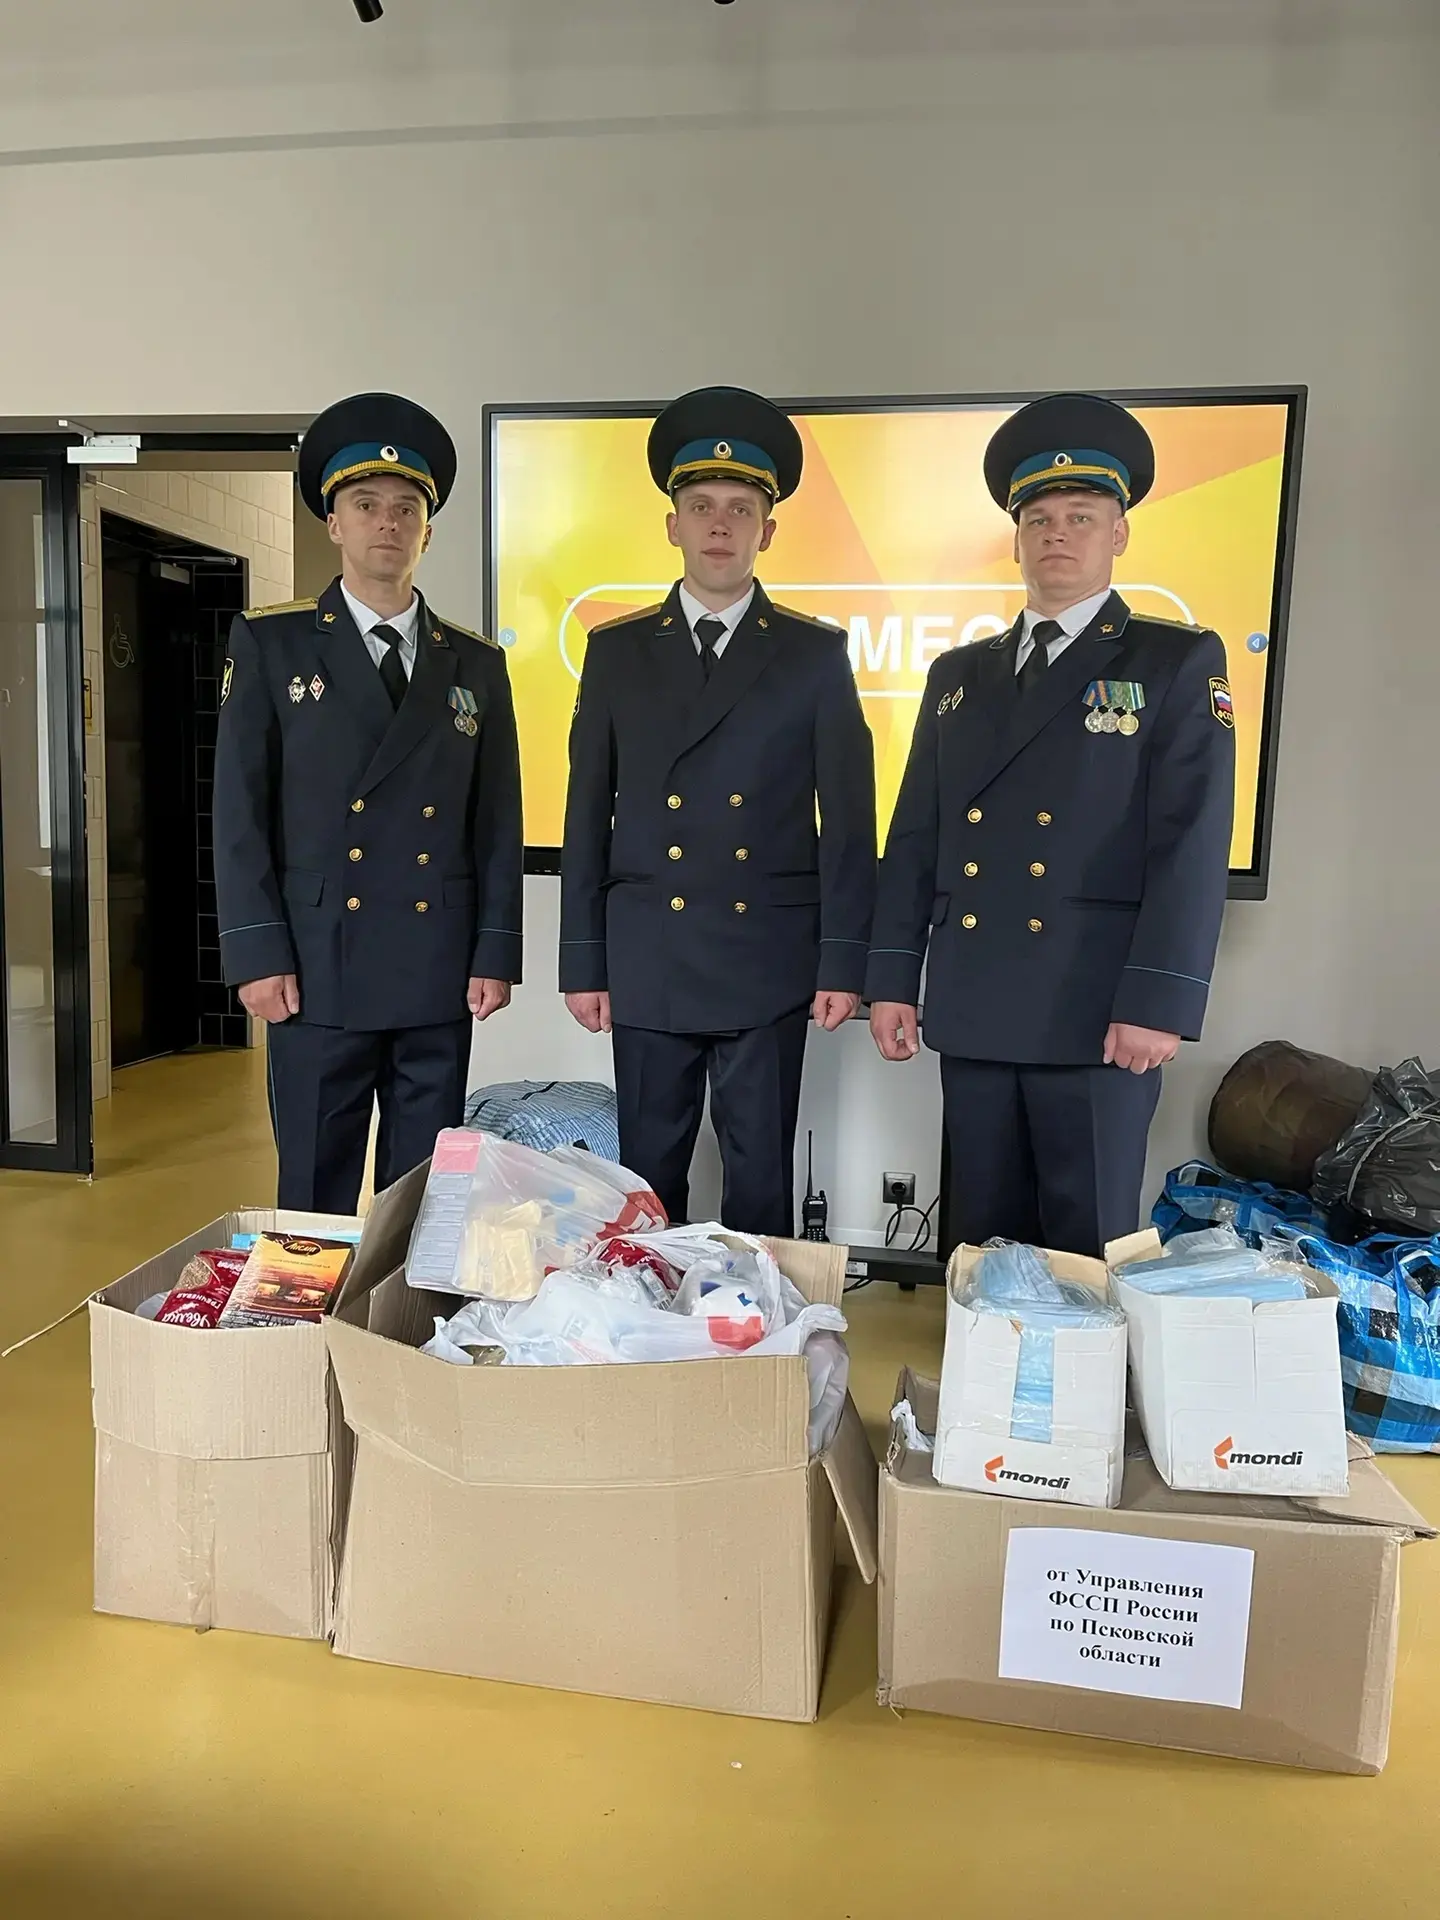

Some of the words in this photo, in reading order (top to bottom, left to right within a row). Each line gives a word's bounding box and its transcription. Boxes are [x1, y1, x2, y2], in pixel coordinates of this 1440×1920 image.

[1217, 709, 1234, 722] ФСС
[176, 1291, 223, 1310] ГРЕЧНЕВАЯ
[161, 1311, 210, 1328] Увелка
[1229, 1450, 1304, 1466] mondi
[998, 1468, 1070, 1491] mondi
[1046, 1569, 1070, 1583] от
[1075, 1568, 1204, 1599] Управления
[1048, 1590, 1119, 1614] ФССП
[1126, 1599, 1199, 1623] России
[1049, 1618, 1074, 1632] по
[1081, 1618, 1194, 1647] Псковской
[1078, 1644, 1162, 1668] области
